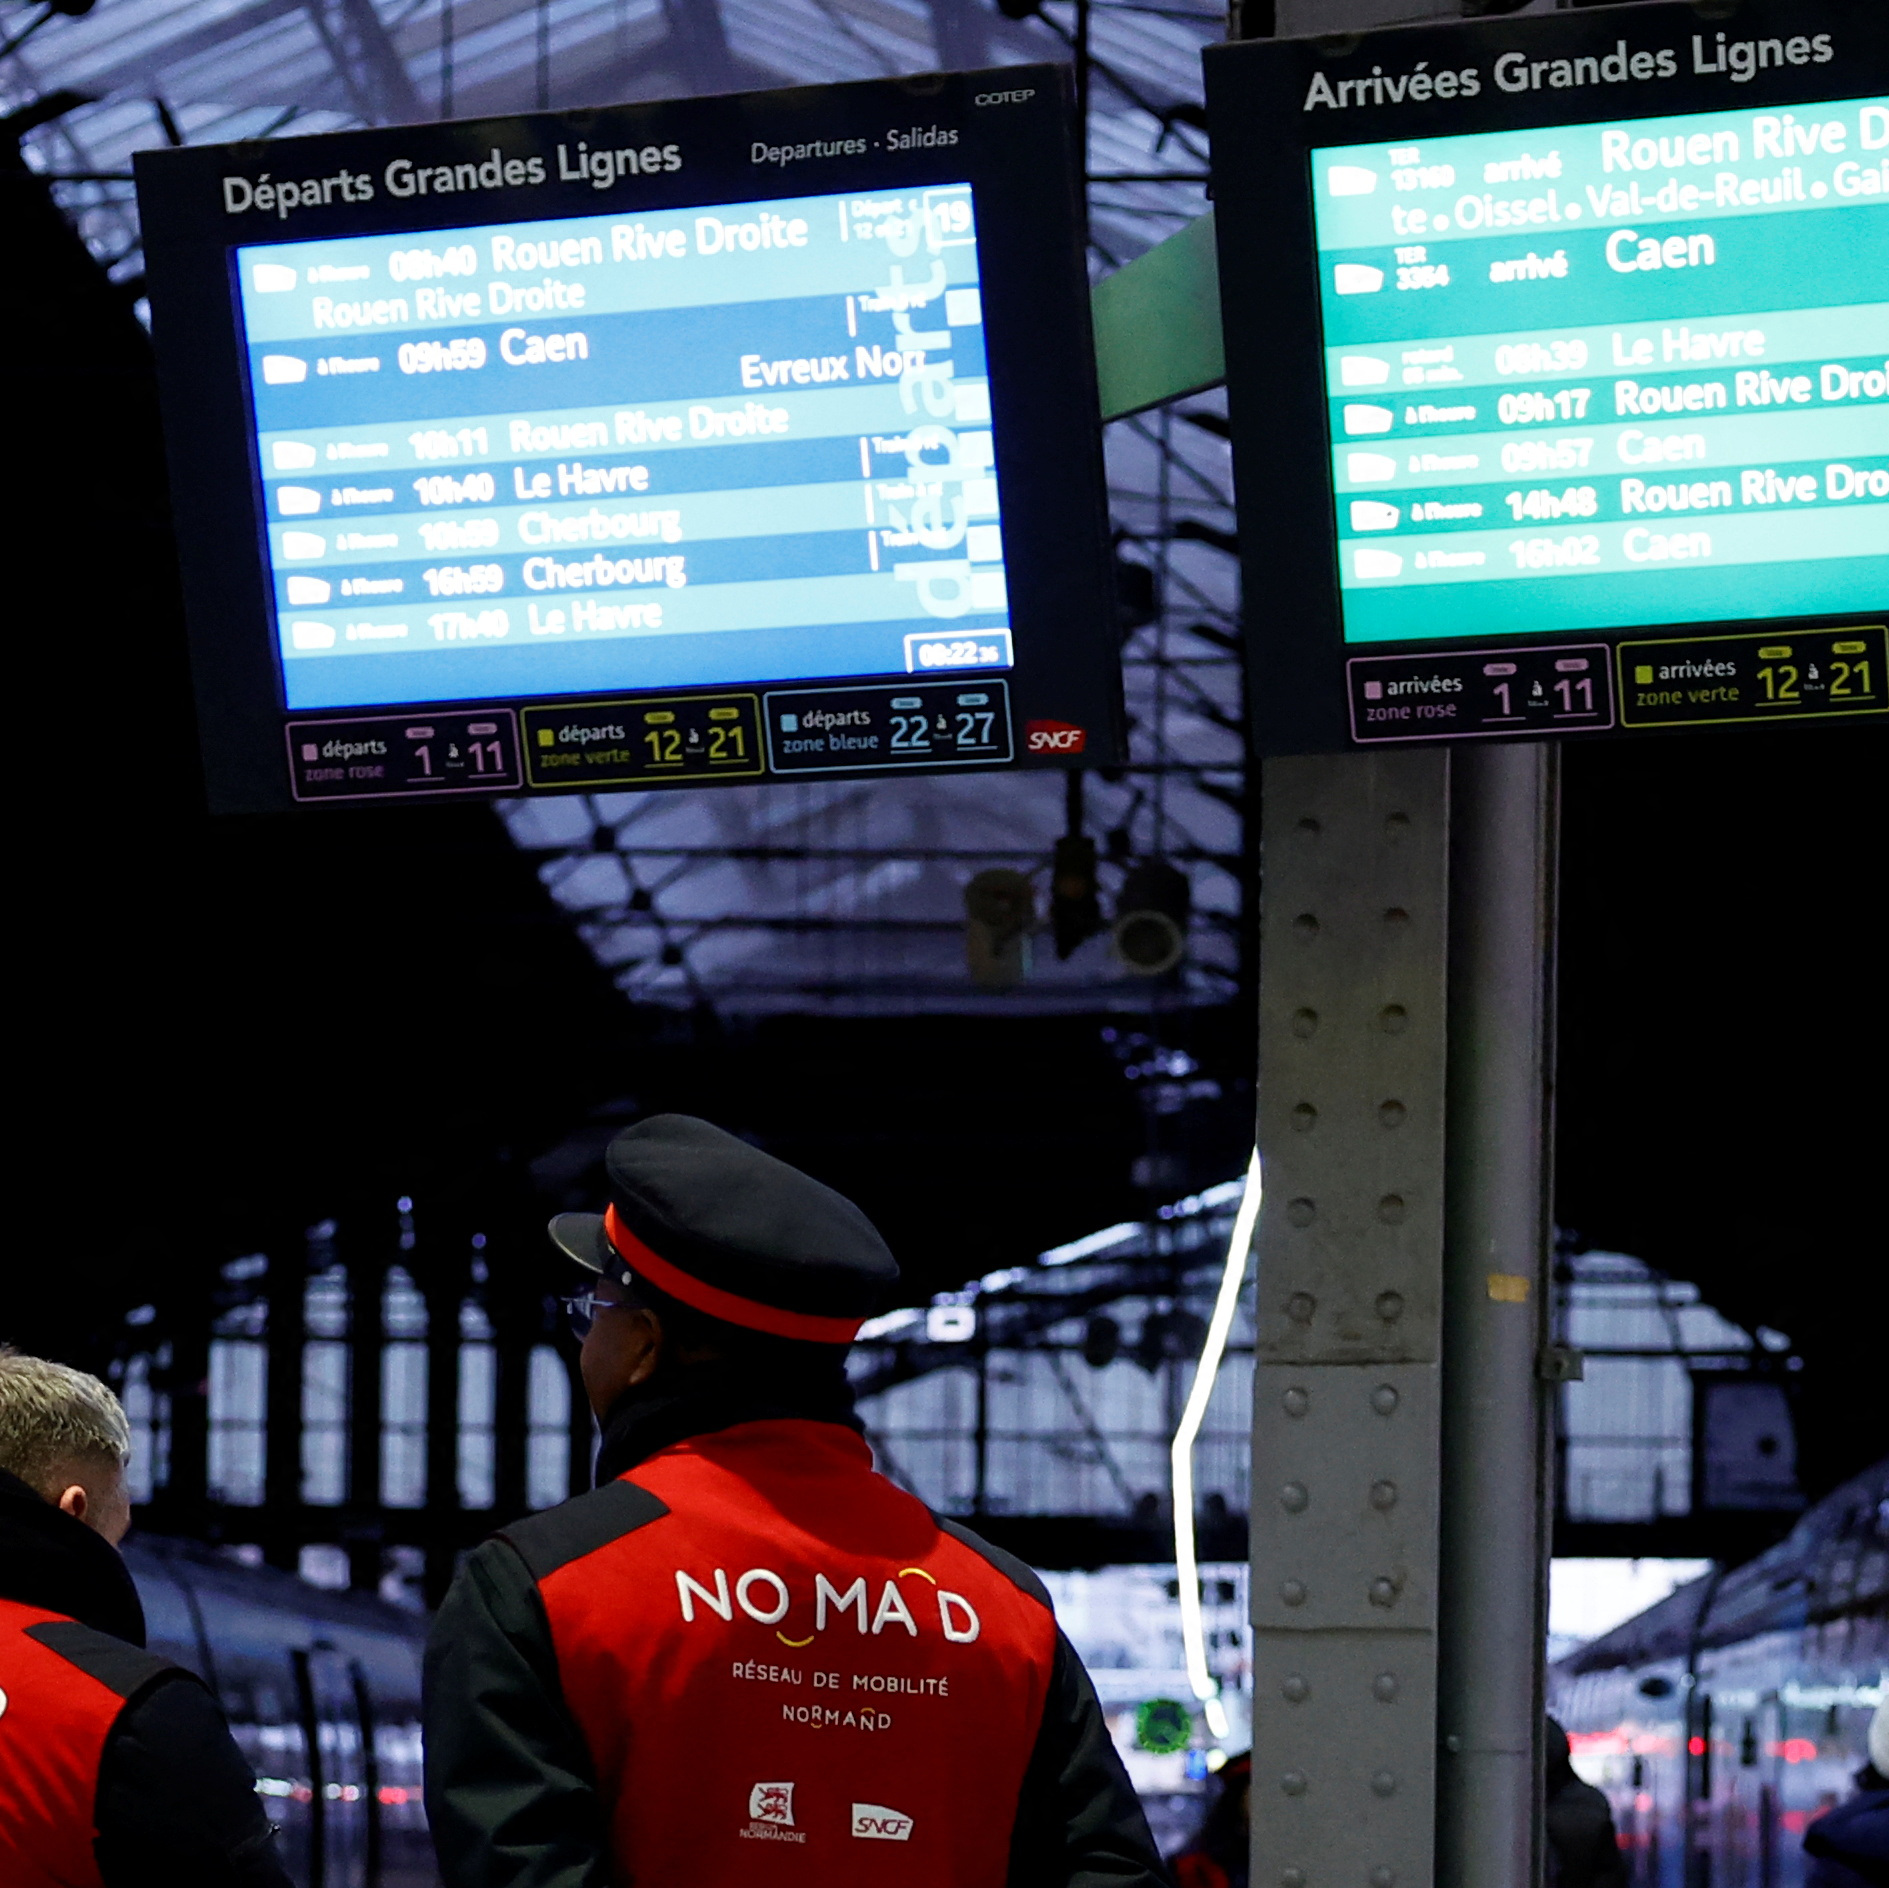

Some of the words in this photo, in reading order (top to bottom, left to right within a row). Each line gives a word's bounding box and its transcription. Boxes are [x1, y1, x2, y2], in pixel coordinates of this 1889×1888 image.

[1303, 59, 1481, 112] Arrivées
[1492, 39, 1678, 96] Grandes
[1690, 29, 1835, 80] Lignes
[751, 137, 867, 167] Departures
[886, 124, 959, 152] Salidas
[1484, 152, 1562, 183] arrivé
[1602, 130, 1739, 173] Rouen
[1753, 114, 1846, 160] Rive
[223, 167, 374, 218] Départs
[385, 147, 547, 201] Grandes
[558, 138, 683, 192] Lignes
[933, 201, 970, 232] 19
[1392, 204, 1427, 236] te
[1454, 189, 1559, 230] Oissel
[1586, 166, 1806, 219] Val-de-Reuil
[492, 236, 602, 272] Rouen
[612, 224, 686, 261] Rive
[695, 212, 809, 251] Droite
[1489, 251, 1567, 282] arrivé
[1606, 230, 1714, 273] Caen
[313, 297, 408, 328] Rouen
[416, 288, 481, 320] Rive
[489, 279, 586, 314] Droite
[399, 338, 486, 374] 09h59
[500, 329, 588, 365] Caen
[1612, 333, 1654, 367] Le
[1662, 328, 1764, 362] Havre
[741, 353, 849, 387] Evreux
[875, 205, 986, 618] départs
[1498, 389, 1590, 424] 09h17
[1615, 381, 1725, 415] Rouen
[1736, 368, 1810, 407] Rive
[408, 427, 488, 459] 10h11
[509, 420, 608, 452] Rouen
[615, 410, 682, 444] Rive
[690, 402, 790, 438] Droite
[1500, 438, 1594, 473] 09h57
[1617, 429, 1706, 464] Caen
[414, 473, 493, 505] 10h40
[514, 467, 550, 498] Le
[558, 463, 648, 495] Havre
[1506, 487, 1597, 521] 14h48
[1621, 478, 1731, 513] Rouen
[1742, 469, 1816, 505] Rive
[518, 508, 682, 543] Cherbourg
[1623, 527, 1711, 561] Caen
[523, 553, 686, 588] Cherbourg
[528, 603, 565, 635] Le
[572, 599, 662, 631] Havre
[1387, 676, 1463, 696] arrivées
[1494, 682, 1511, 715] 1
[1552, 678, 1593, 711] 11
[1636, 689, 1682, 706] zone
[1687, 685, 1740, 703] verte
[1658, 659, 1737, 680] arrivées
[1756, 664, 1800, 701] 12
[1829, 660, 1871, 695] 21
[803, 710, 871, 729] départs
[890, 715, 930, 748] 22
[957, 712, 994, 745] 27
[1366, 705, 1410, 722] zone
[1415, 701, 1457, 718] rose
[323, 739, 387, 760] départs
[415, 746, 433, 776] 1
[468, 740, 503, 773] 11
[540, 751, 581, 767] zone
[585, 747, 631, 765] verte
[559, 723, 625, 744] départs
[644, 729, 683, 762] 12
[707, 726, 745, 758] 21
[783, 737, 825, 753] zone
[828, 733, 879, 750] bleue
[1028, 730, 1081, 751] SNCF
[732, 1659, 803, 1685] RÉSEAU
[814, 1672, 840, 1689] DE
[853, 1675, 950, 1697] MOBILITÉ
[783, 1704, 892, 1731] NORMAND
[739, 1829, 806, 1843] NORMANDIE
[855, 1818, 910, 1835] SNCF
